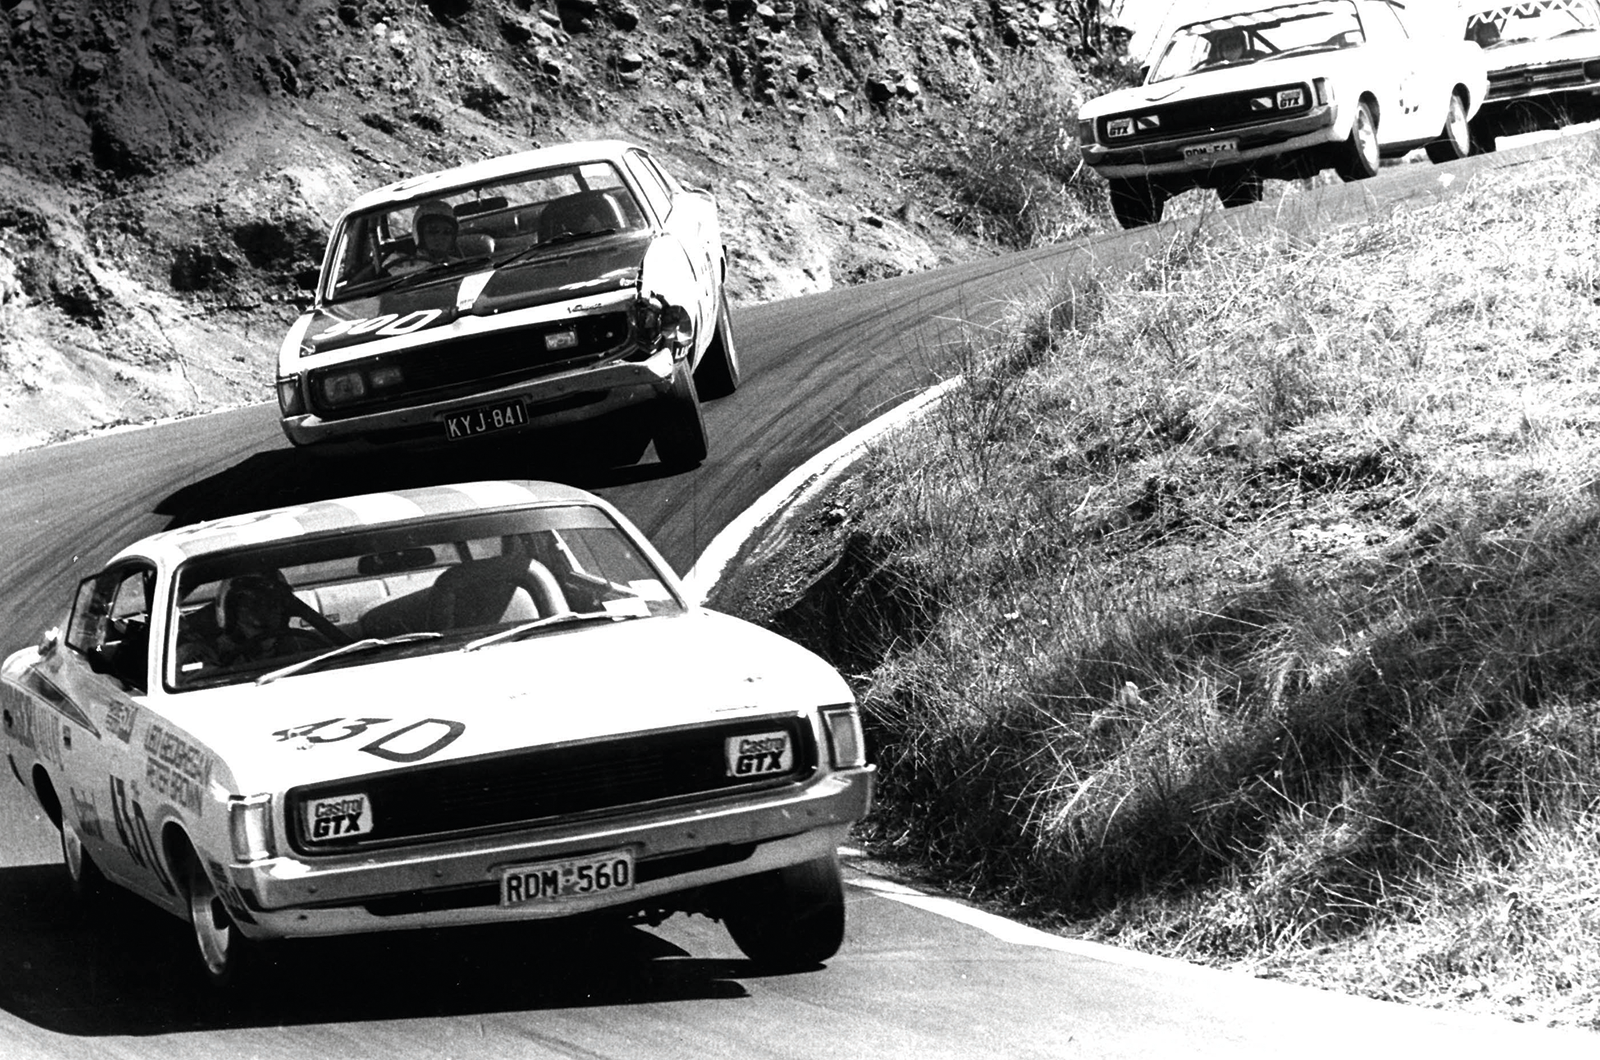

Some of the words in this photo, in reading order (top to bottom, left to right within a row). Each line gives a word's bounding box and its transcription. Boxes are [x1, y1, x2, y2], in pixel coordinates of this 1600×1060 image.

[1279, 97, 1299, 108] GTX
[738, 734, 787, 755] Castrol
[736, 750, 786, 774] GTX
[314, 796, 364, 818] Castrol
[313, 811, 363, 838] GTX
